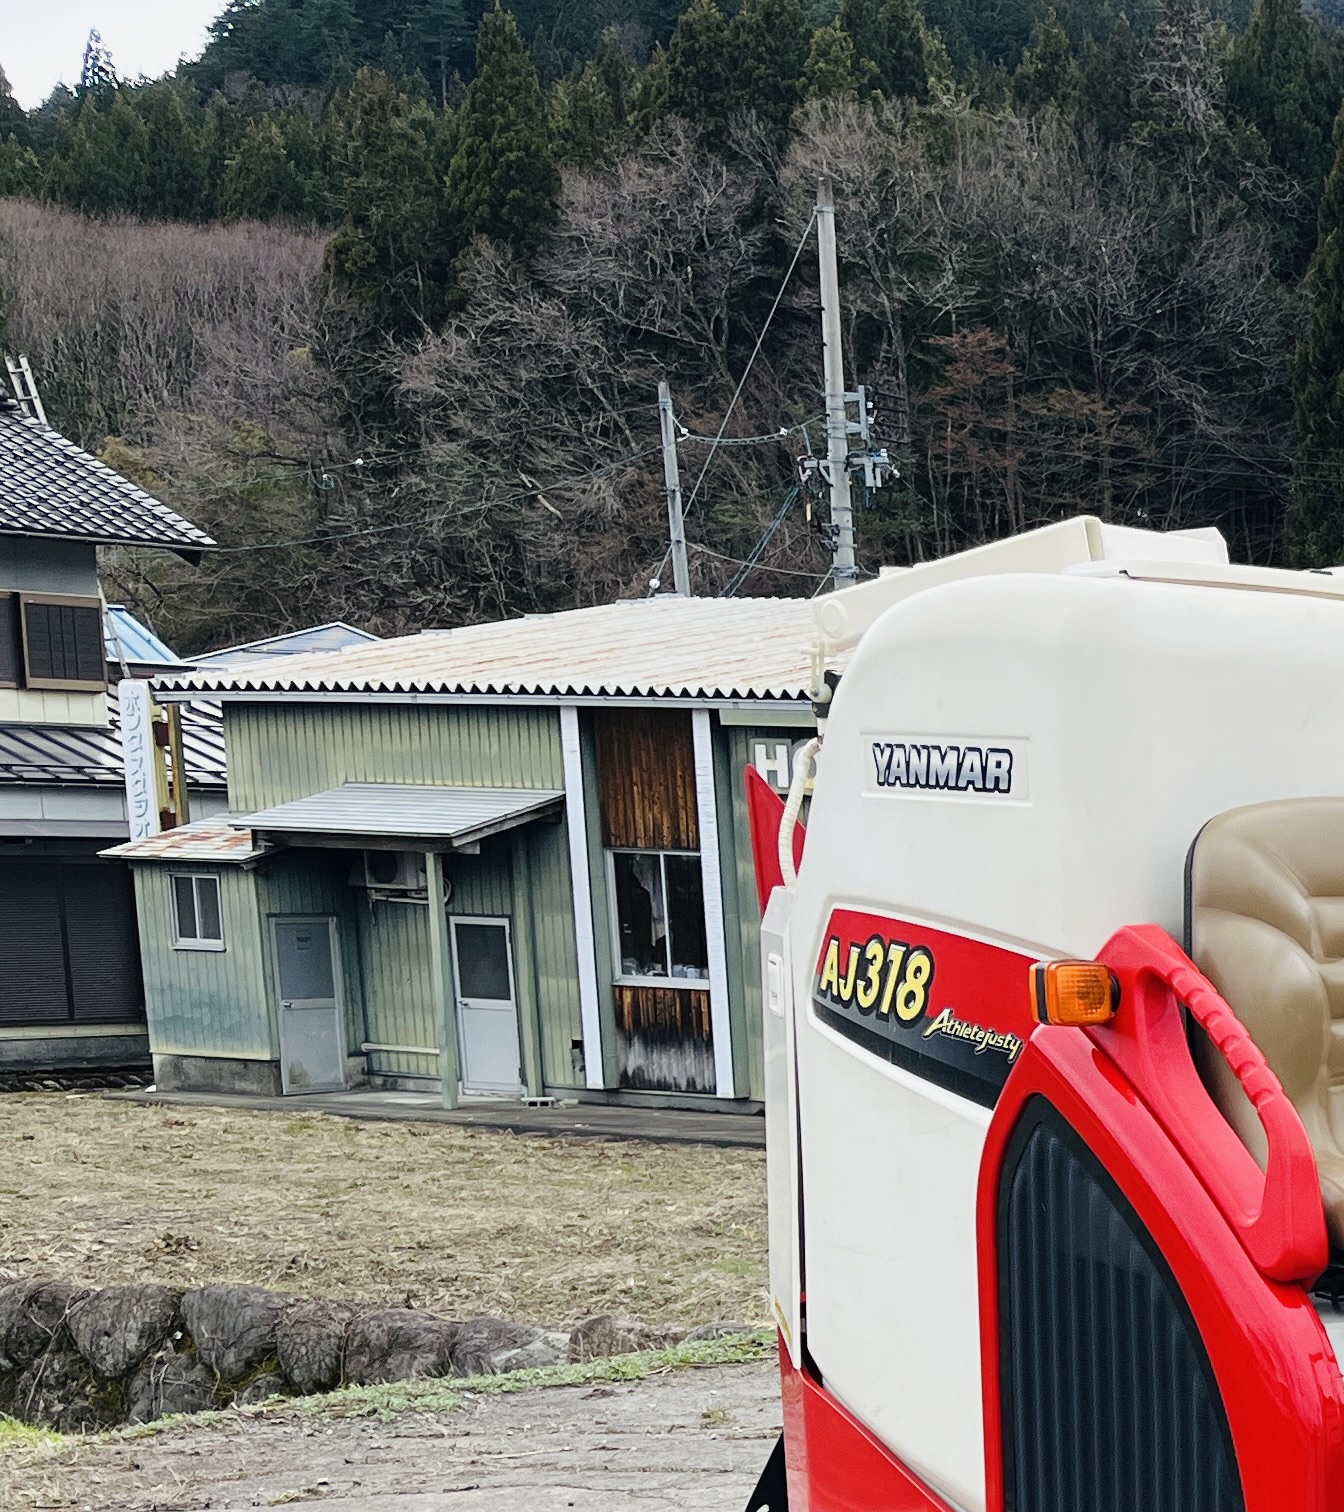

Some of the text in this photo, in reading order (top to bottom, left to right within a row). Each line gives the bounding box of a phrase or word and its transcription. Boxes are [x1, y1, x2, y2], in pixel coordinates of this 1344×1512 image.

[871, 742, 1014, 793] YANMAR
[817, 934, 936, 1028] AJ318
[922, 1008, 1024, 1063] Athletejusty
